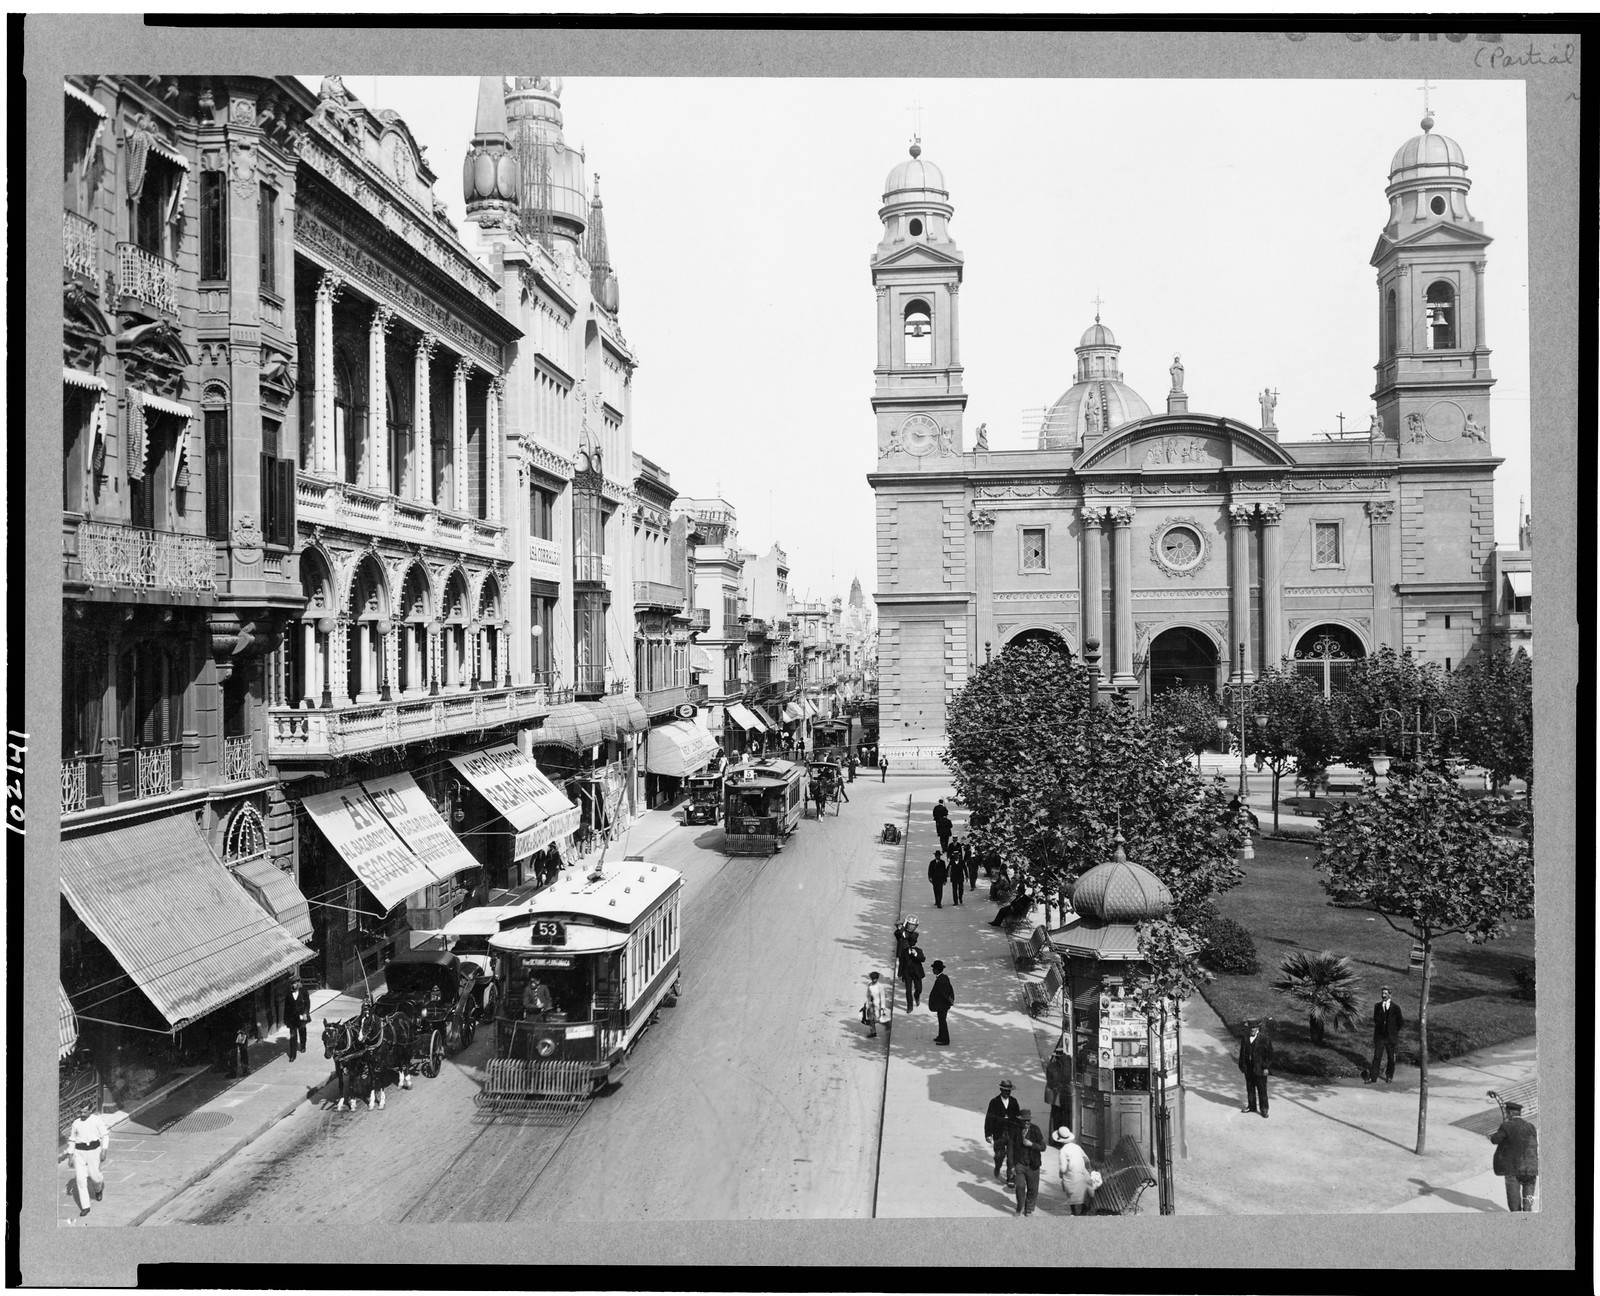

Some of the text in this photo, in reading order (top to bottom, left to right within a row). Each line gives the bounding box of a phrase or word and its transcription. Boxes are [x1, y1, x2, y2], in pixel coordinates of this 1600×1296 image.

[1474, 43, 1575, 68] (Partial
[6, 730, 30, 836] 102141
[463, 756, 497, 779] ANEXO
[746, 770, 752, 778] 5
[340, 787, 409, 831] ANEXO
[484, 780, 529, 811] BAZAR
[513, 773, 554, 798] COLON
[340, 841, 358, 861] AL
[350, 826, 396, 856] BAZARCITO
[399, 816, 425, 836] BAZAR
[356, 845, 419, 891] SECCION
[538, 922, 558, 936] 53
